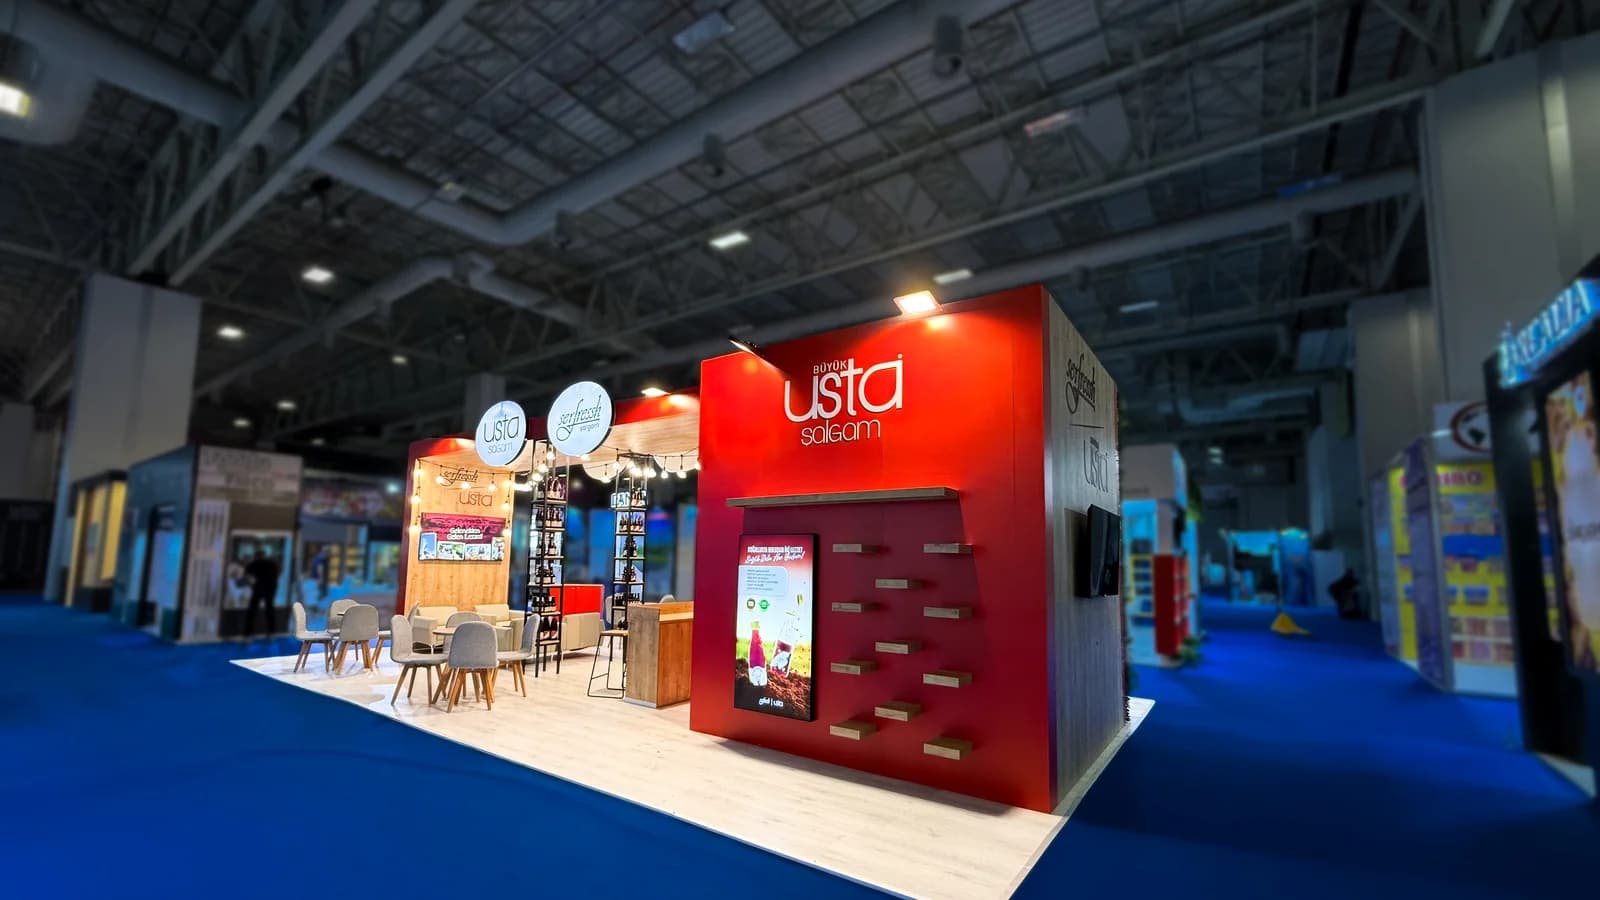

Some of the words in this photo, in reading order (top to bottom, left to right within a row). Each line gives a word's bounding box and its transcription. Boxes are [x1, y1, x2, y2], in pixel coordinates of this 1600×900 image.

[813, 359, 847, 375] BÜYÜK
[484, 414, 519, 443] usta
[459, 491, 493, 507] usta
